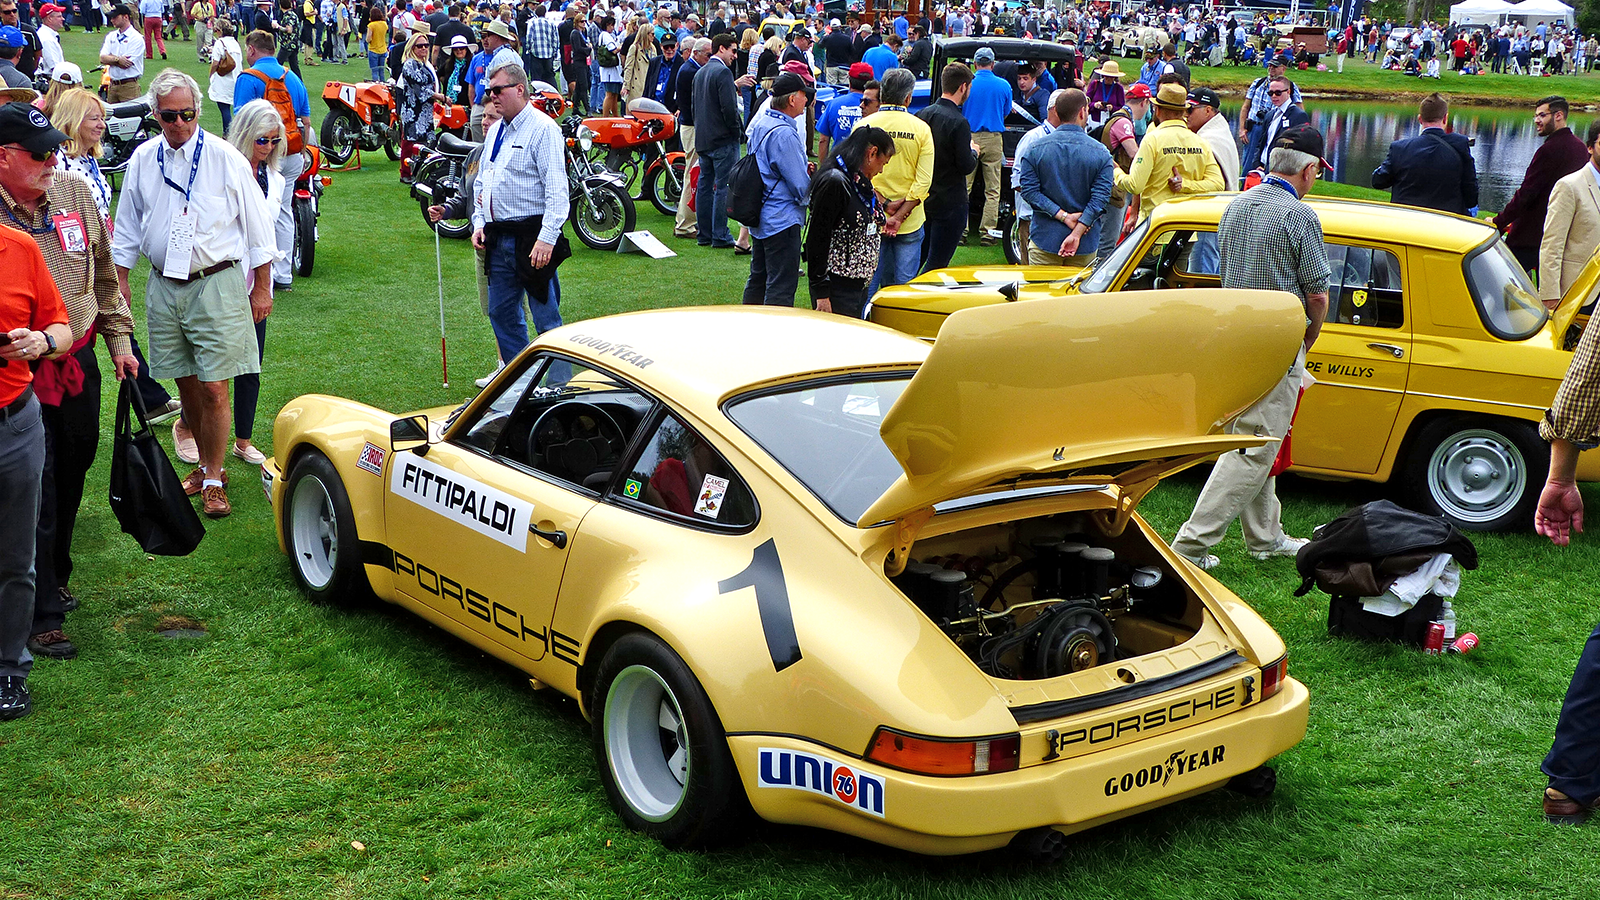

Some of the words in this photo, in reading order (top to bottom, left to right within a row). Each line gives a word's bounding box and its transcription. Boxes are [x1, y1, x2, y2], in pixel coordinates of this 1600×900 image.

[345, 87, 351, 102] 1
[897, 131, 915, 140] MARX
[1122, 123, 1133, 135] 3
[1328, 363, 1375, 378] WILLYS
[402, 462, 517, 536] FITTIPALDI
[394, 550, 580, 667] PORSCHE
[717, 537, 804, 673] 1
[1060, 685, 1236, 751] PORSCHE
[837, 774, 854, 795] 76
